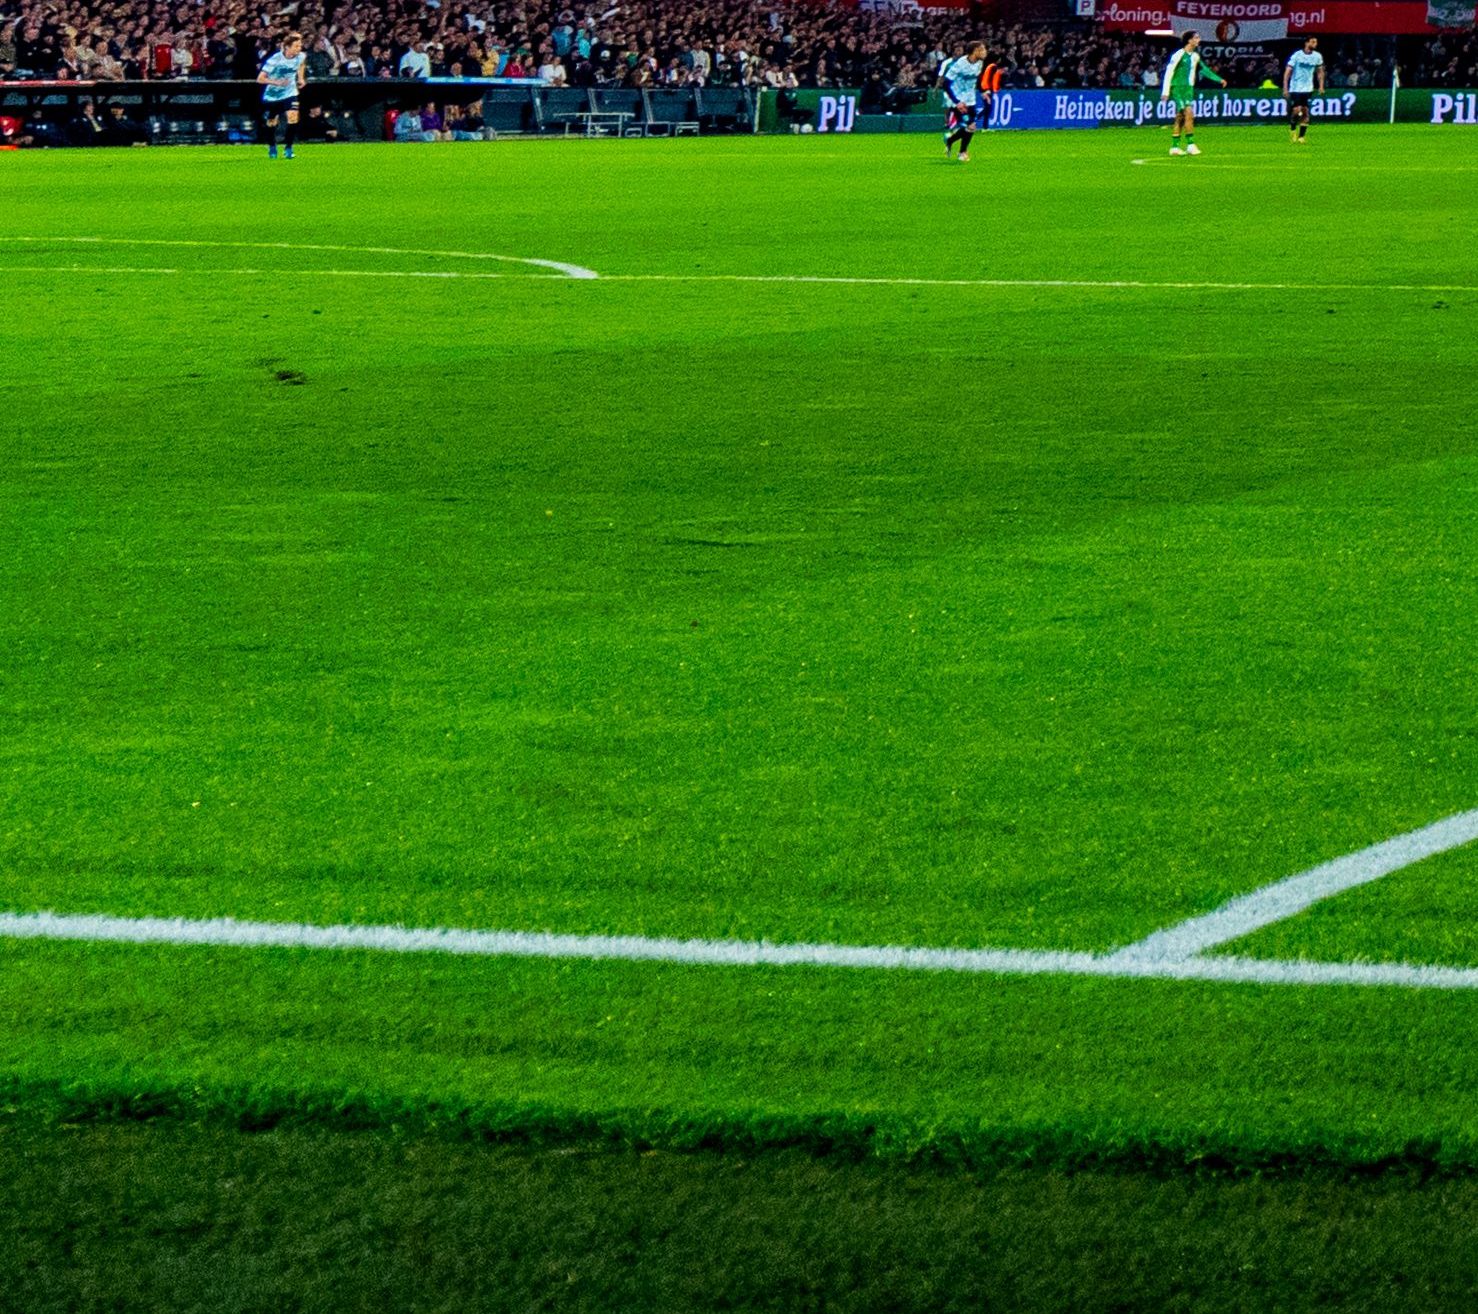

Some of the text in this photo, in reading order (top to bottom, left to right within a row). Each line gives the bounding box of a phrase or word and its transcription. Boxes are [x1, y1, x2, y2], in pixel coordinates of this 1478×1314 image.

[1177, 1, 1282, 18] FEYENOORD
[1055, 95, 1134, 120] Heineken
[1136, 94, 1153, 125] je
[1157, 95, 1176, 119] da
[1222, 93, 1288, 117] horen
[1310, 92, 1356, 116] an?
